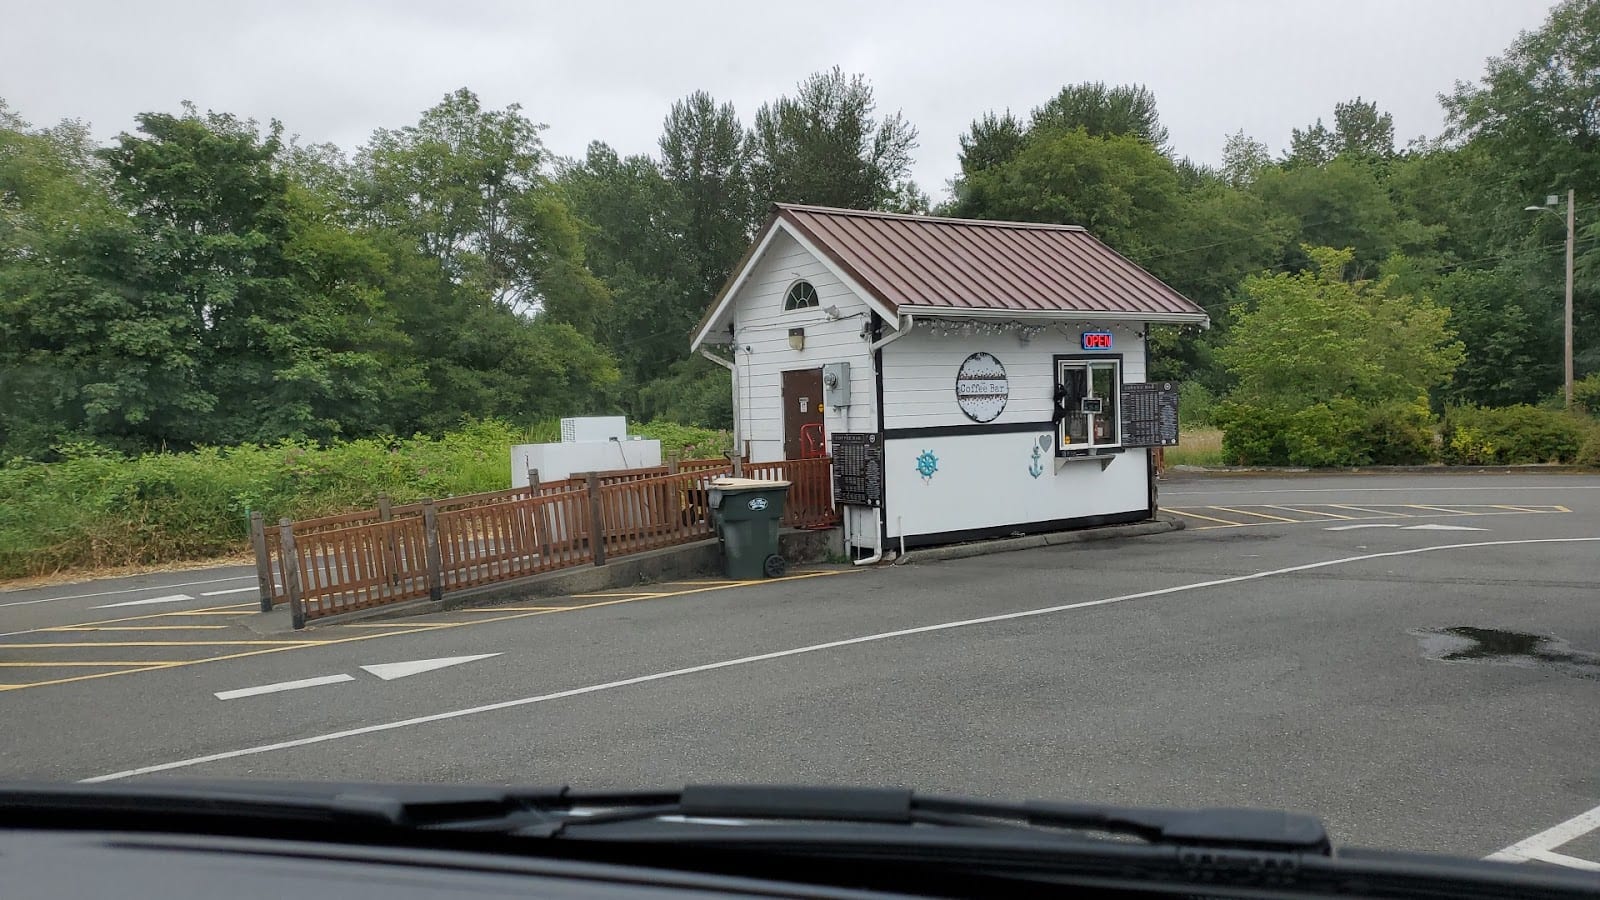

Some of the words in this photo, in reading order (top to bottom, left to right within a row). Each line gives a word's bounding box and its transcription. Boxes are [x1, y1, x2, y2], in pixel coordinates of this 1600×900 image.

[1086, 335, 1111, 347] OPEN
[960, 383, 987, 393] Coffee
[989, 383, 1005, 393] Bar
